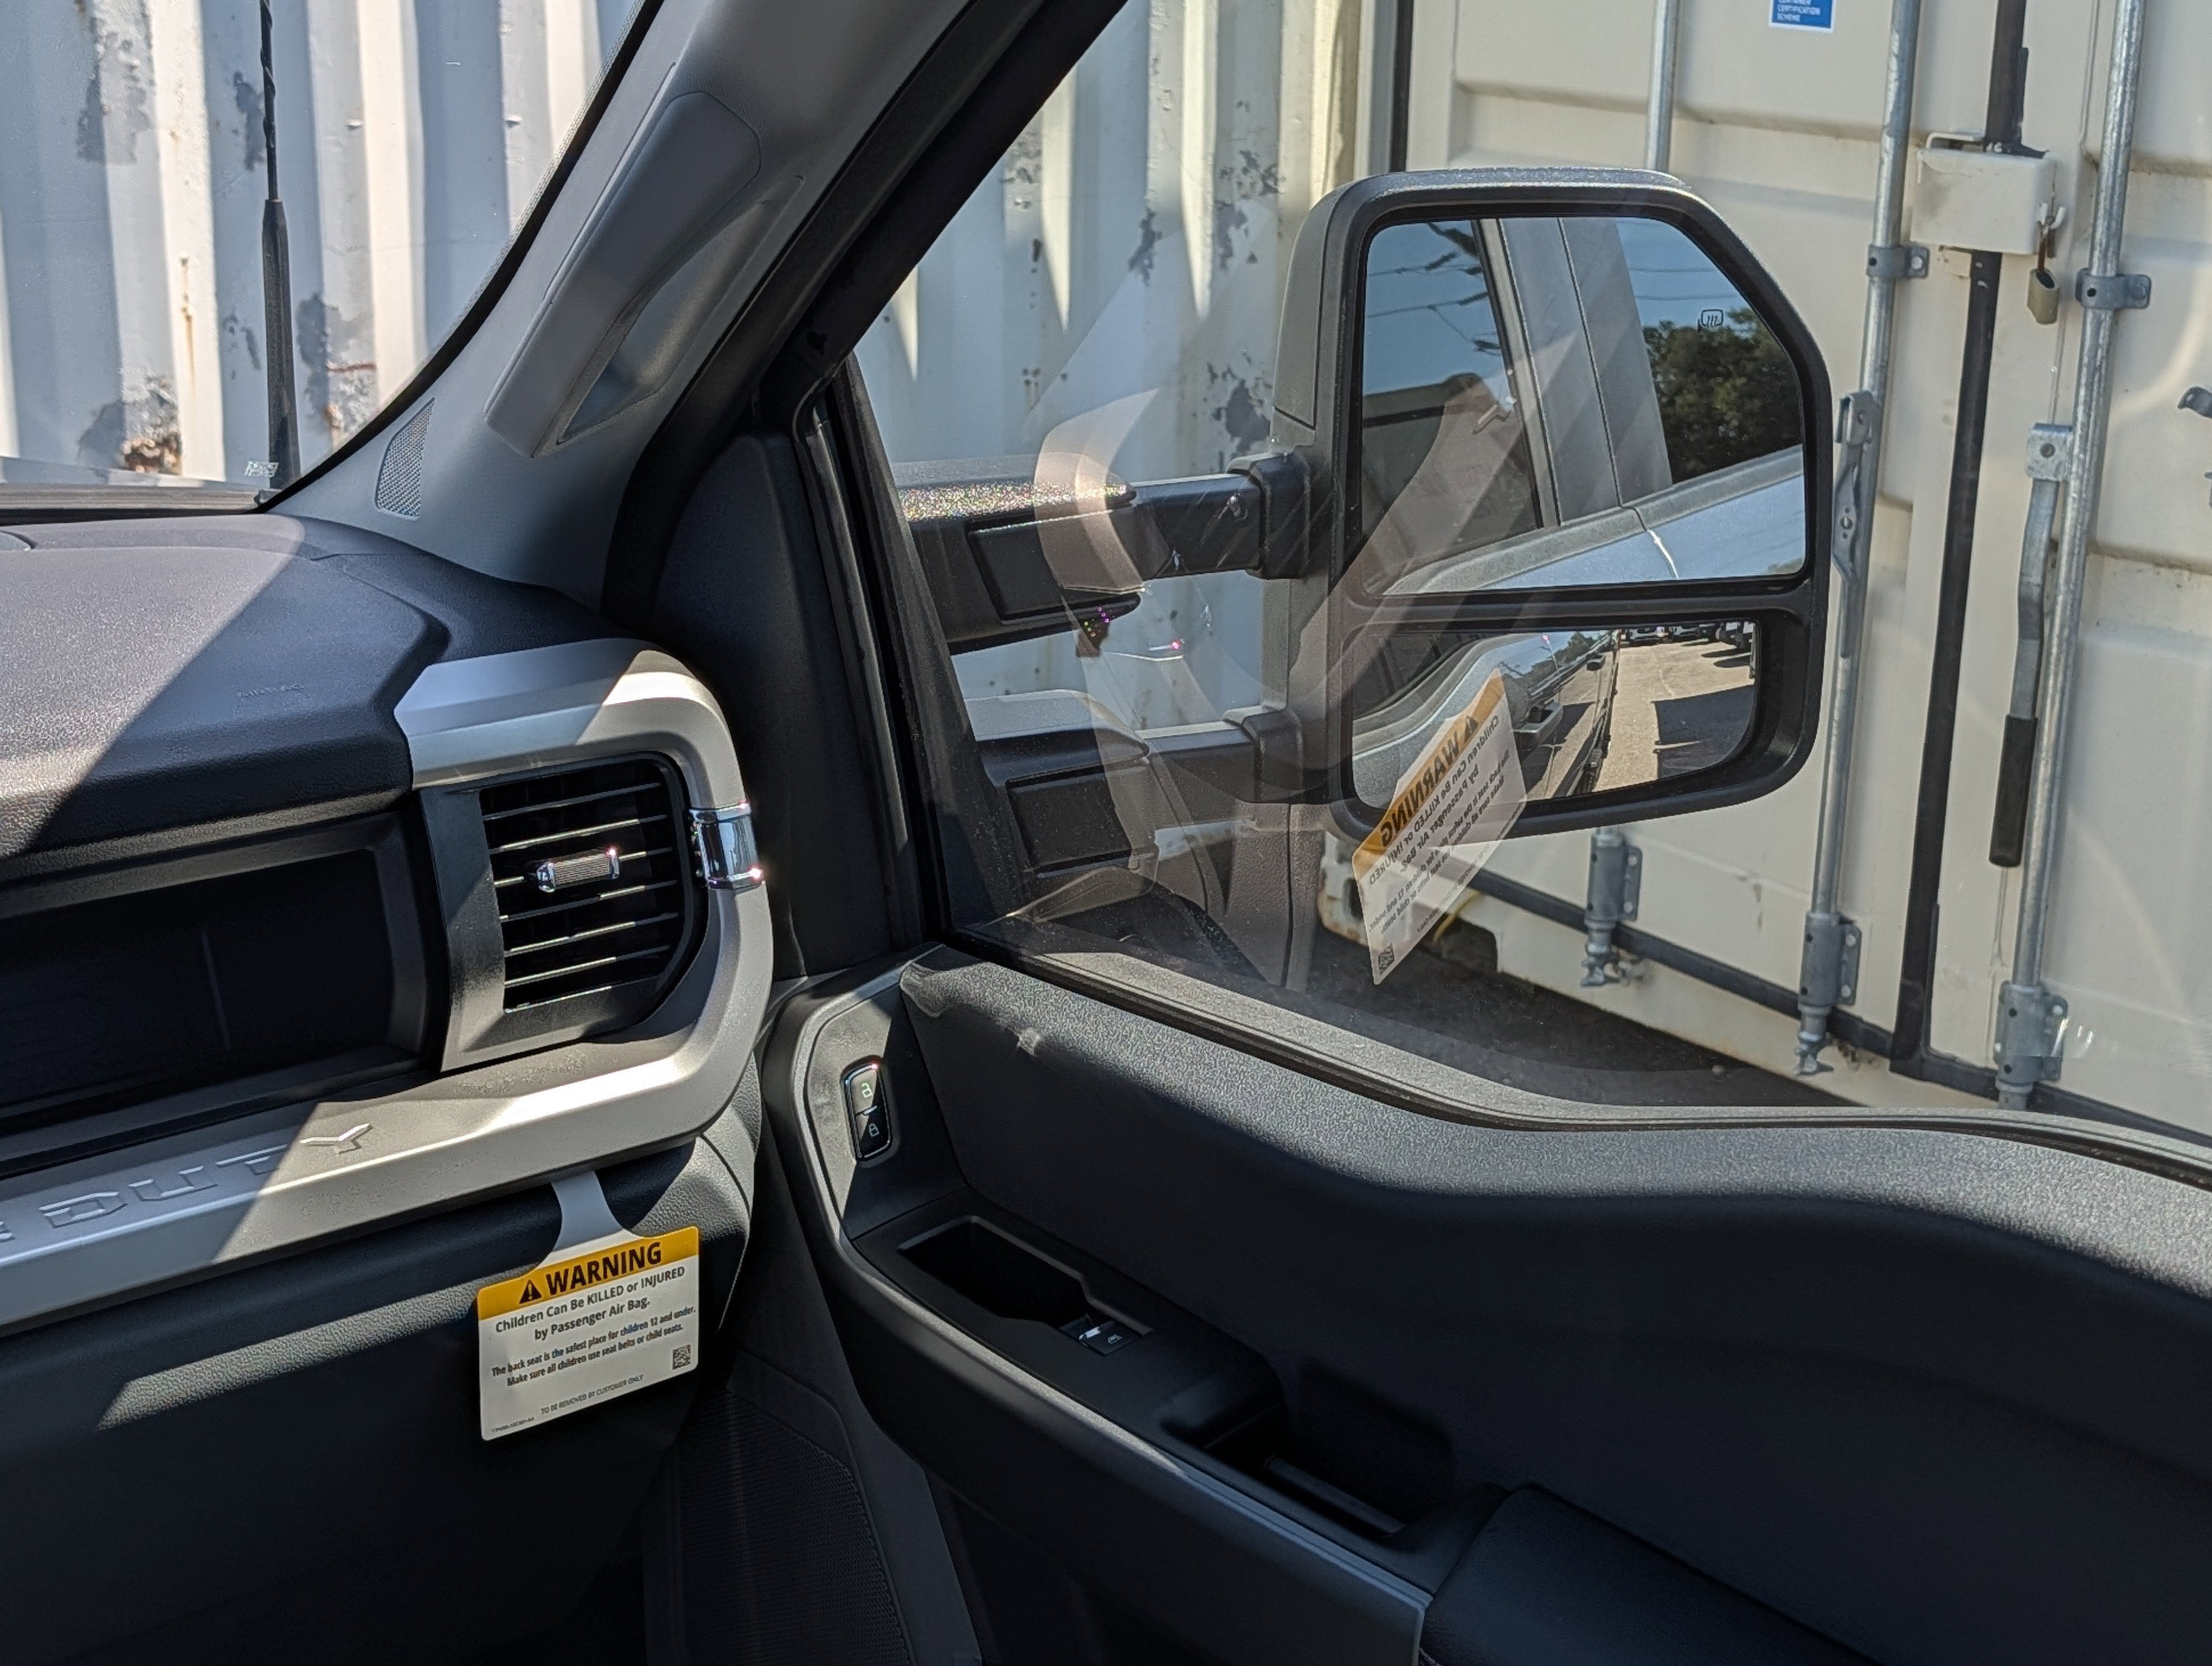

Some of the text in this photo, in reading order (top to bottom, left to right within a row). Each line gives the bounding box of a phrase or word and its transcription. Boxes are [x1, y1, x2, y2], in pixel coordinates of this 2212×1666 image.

[40, 1123, 373, 1228] DUTY
[496, 1266, 685, 1333] Children Can Be KILLED or INJURED
[545, 1242, 661, 1296] WARNING
[491, 1306, 696, 1377] The back seat is the safest place for children 12 and under.
[535, 1297, 651, 1341] by Passenger Air Bag.
[507, 1323, 684, 1387] Make sure all children use seat belts or child seats.
[540, 1374, 644, 1415] TO BE REMOVED BY CUSTOMER ONLY
